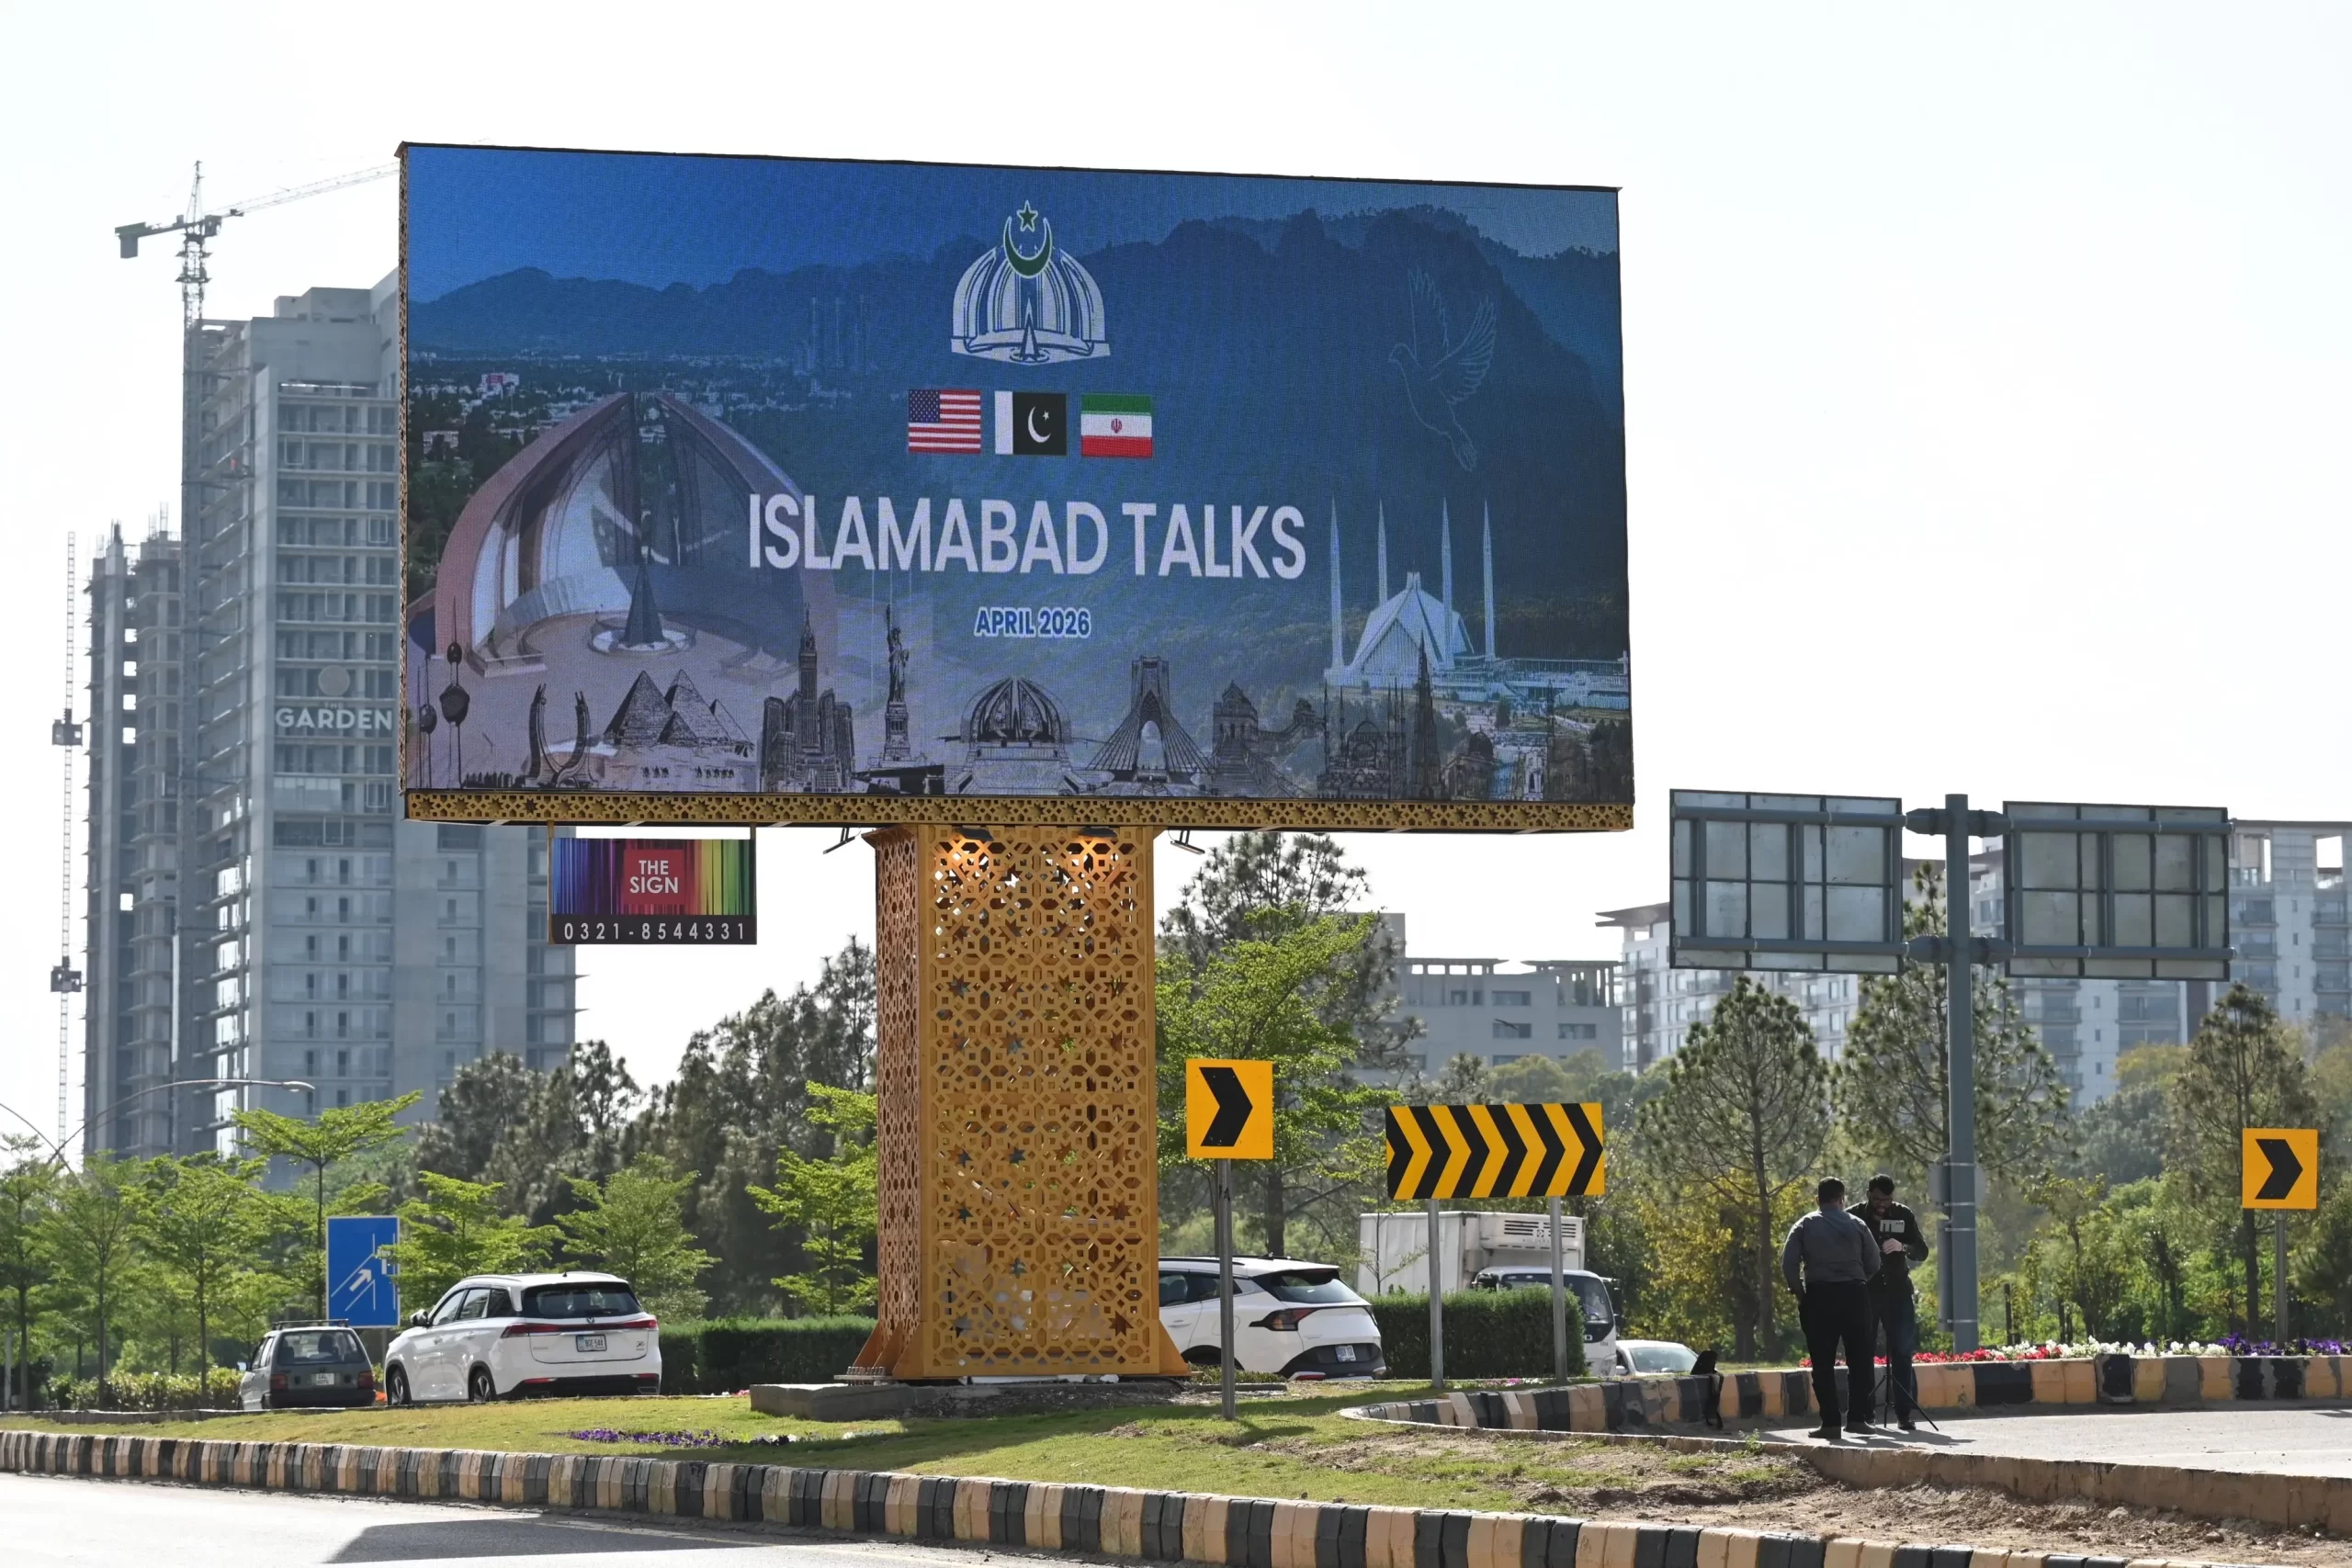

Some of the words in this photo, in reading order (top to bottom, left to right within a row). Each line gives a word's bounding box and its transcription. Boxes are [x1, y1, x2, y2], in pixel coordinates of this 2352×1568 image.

[749, 493, 1109, 574] ISLAMABAD
[1122, 502, 1306, 580] TALKS
[975, 607, 1036, 637] APRIL
[1038, 607, 1091, 637] 2026
[323, 701, 345, 709] THE
[275, 707, 393, 731] GARDEN
[639, 860, 669, 875] THE
[629, 876, 679, 894] SIGN
[563, 922, 744, 940] 0321-8544331
